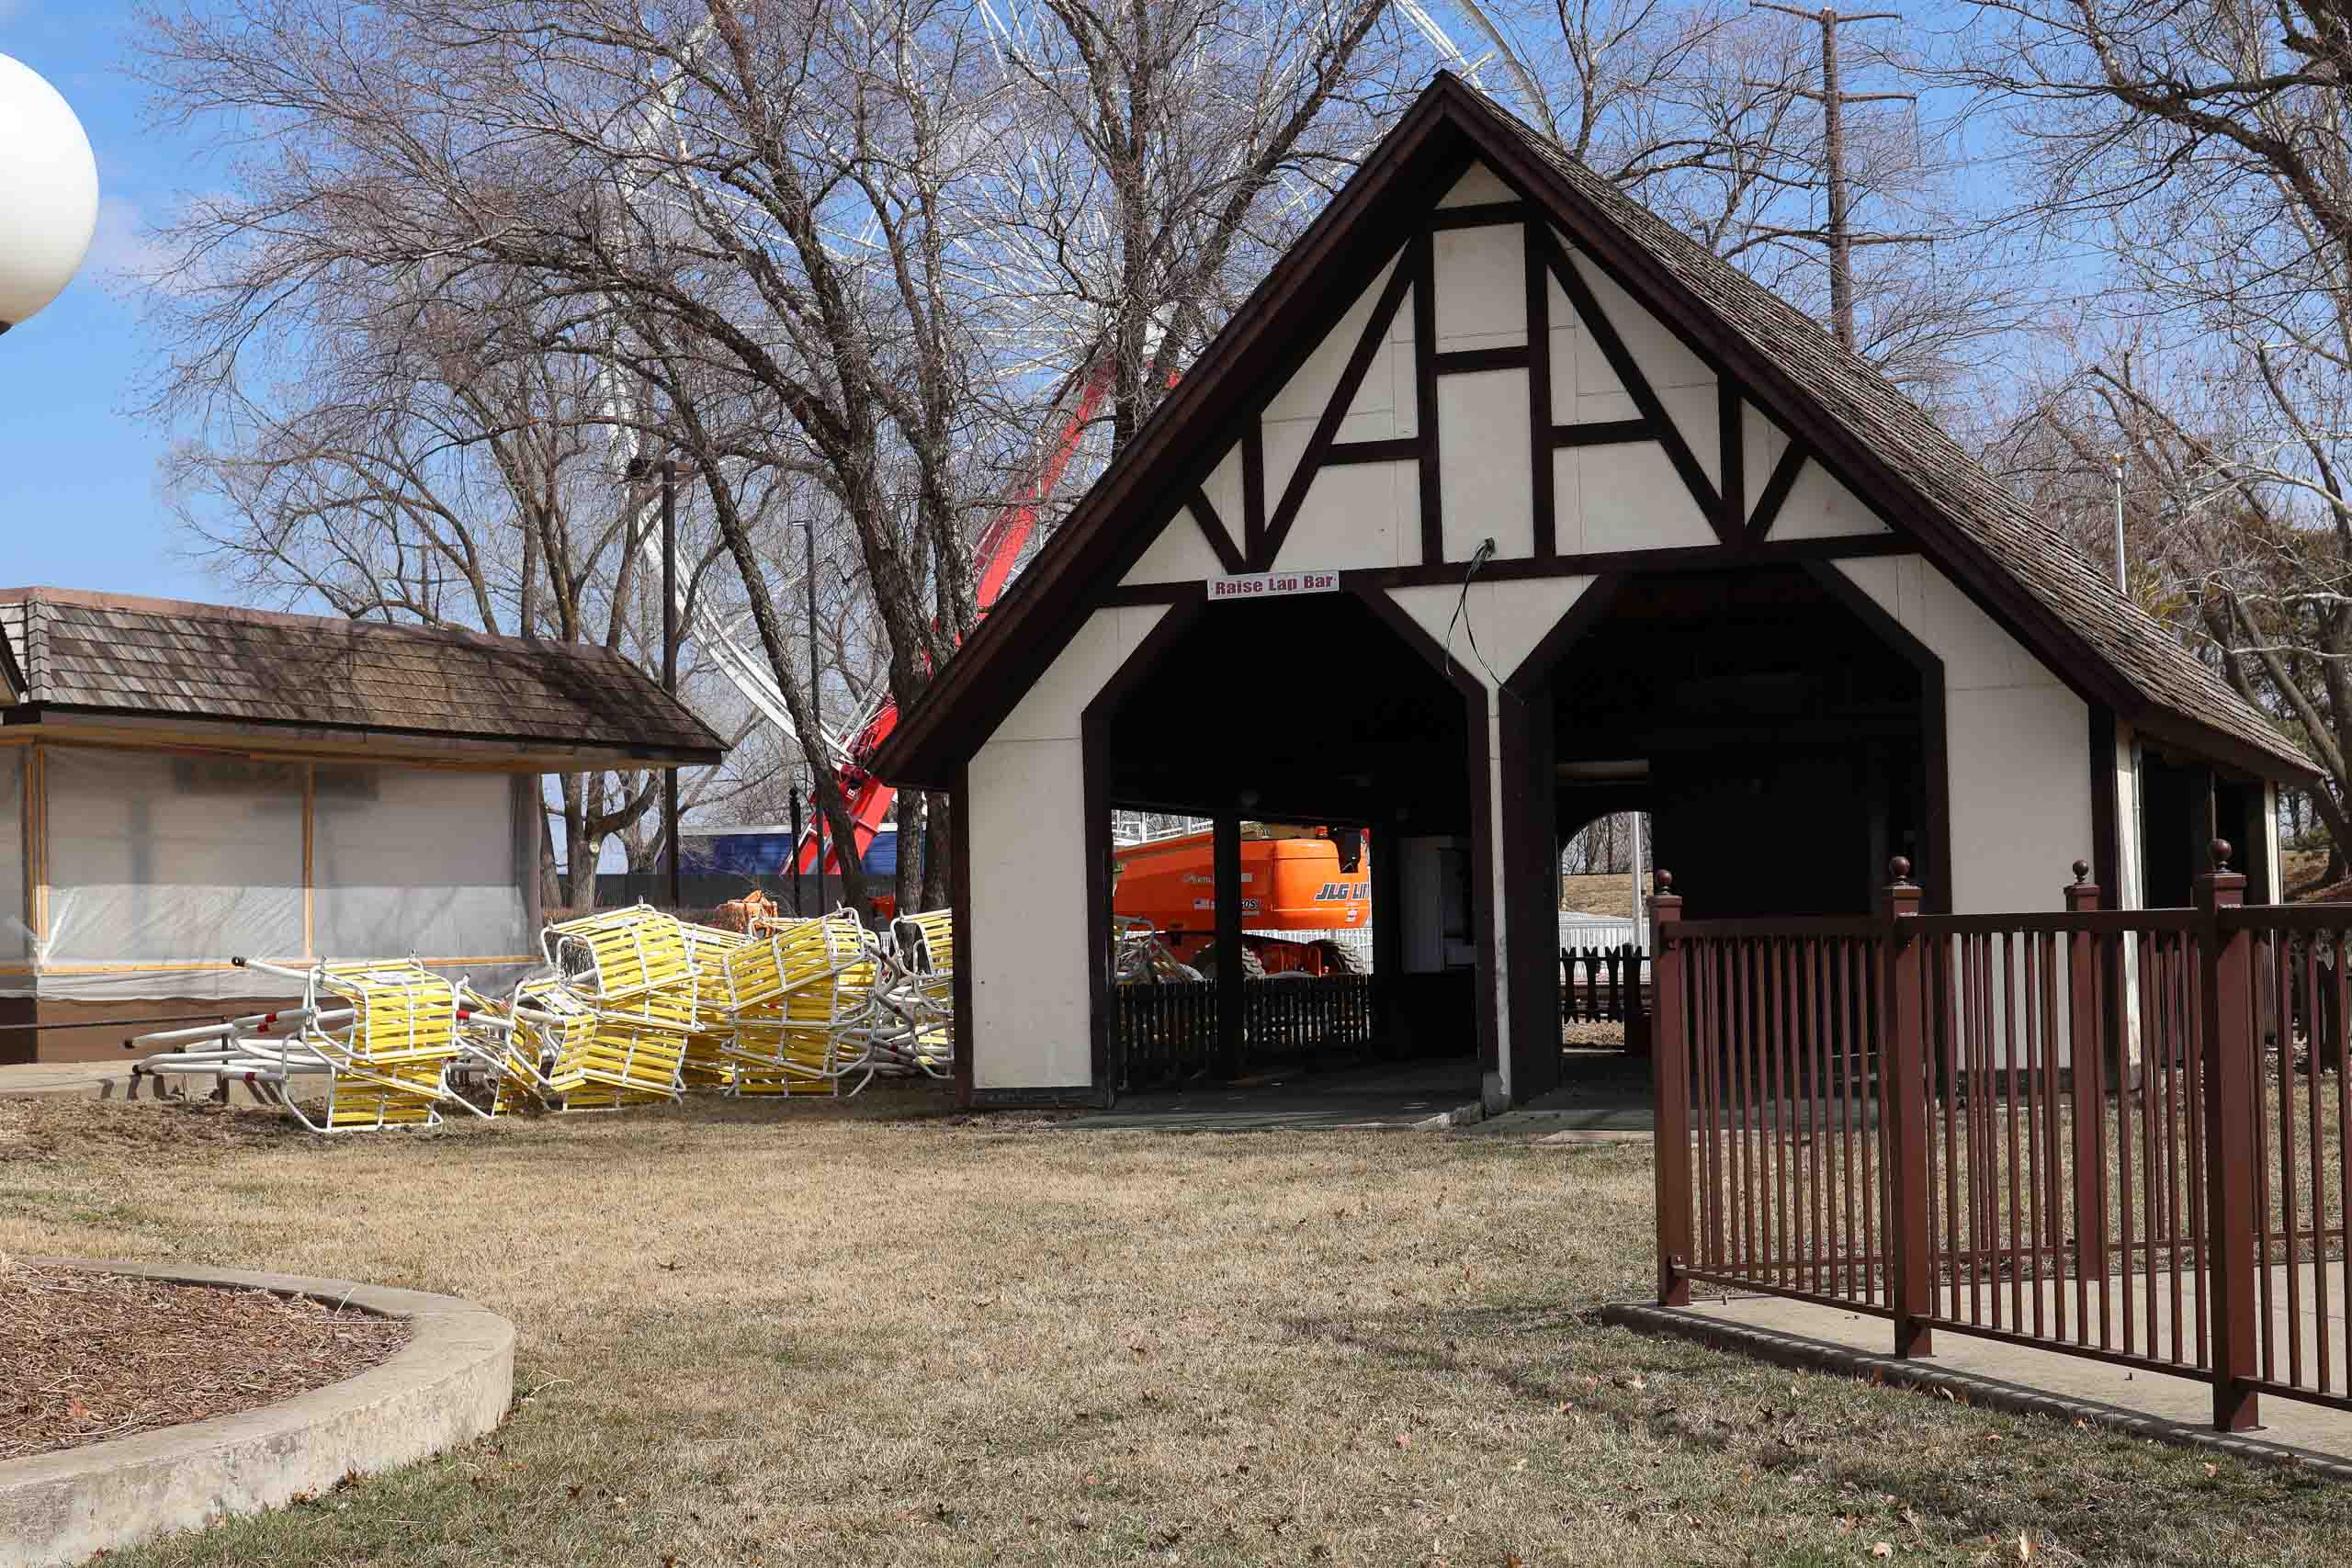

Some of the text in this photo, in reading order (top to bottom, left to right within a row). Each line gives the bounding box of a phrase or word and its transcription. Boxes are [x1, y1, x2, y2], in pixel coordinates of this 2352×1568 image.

[1216, 575, 1333, 595] Raise Lap Bar
[1315, 882, 1350, 900] JLG
